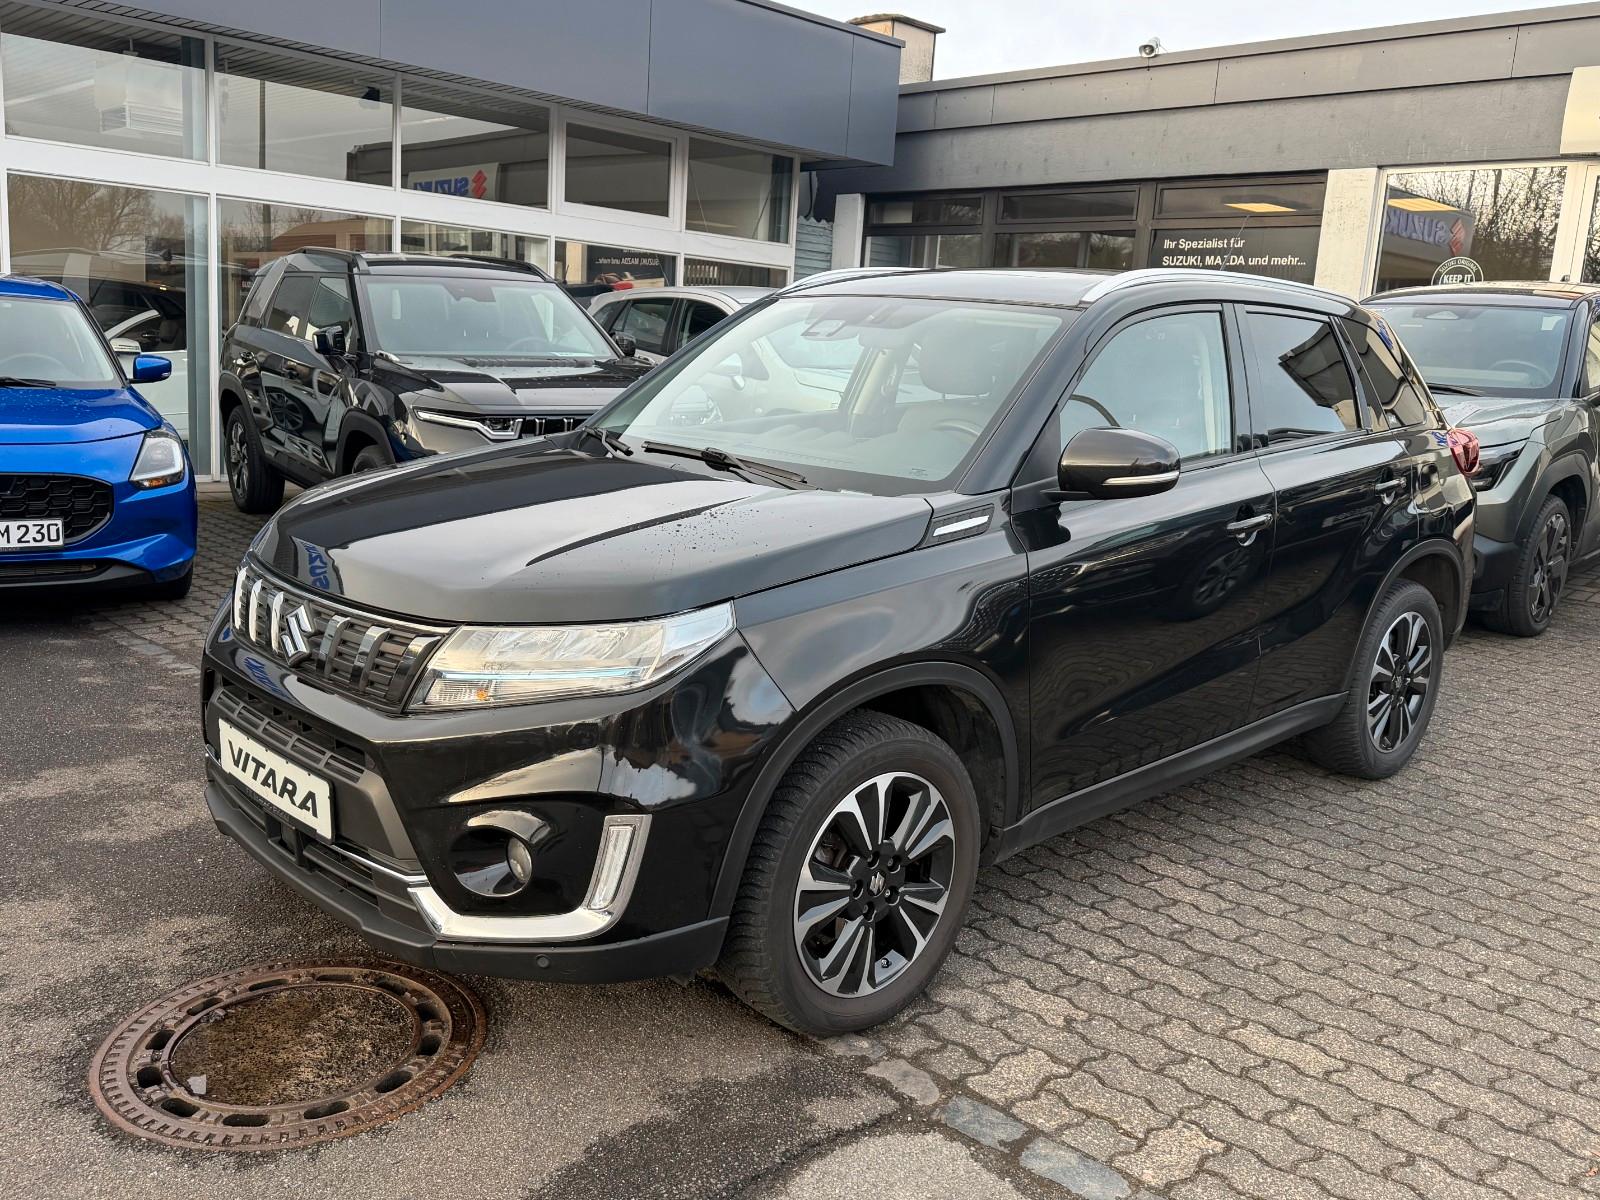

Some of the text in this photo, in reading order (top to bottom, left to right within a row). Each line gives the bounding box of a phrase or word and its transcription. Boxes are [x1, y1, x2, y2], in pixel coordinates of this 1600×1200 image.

[1164, 237, 1245, 251] Ihr Spezialist für
[1162, 255, 1203, 267] SUZUKI,
[1248, 255, 1269, 265] und
[1271, 254, 1306, 266] mehr...
[1439, 259, 1478, 273] SUZUKI ORIGINAL
[1443, 274, 1472, 284] KEEP IT
[16, 523, 60, 543] 230
[228, 739, 318, 819] VITARA
